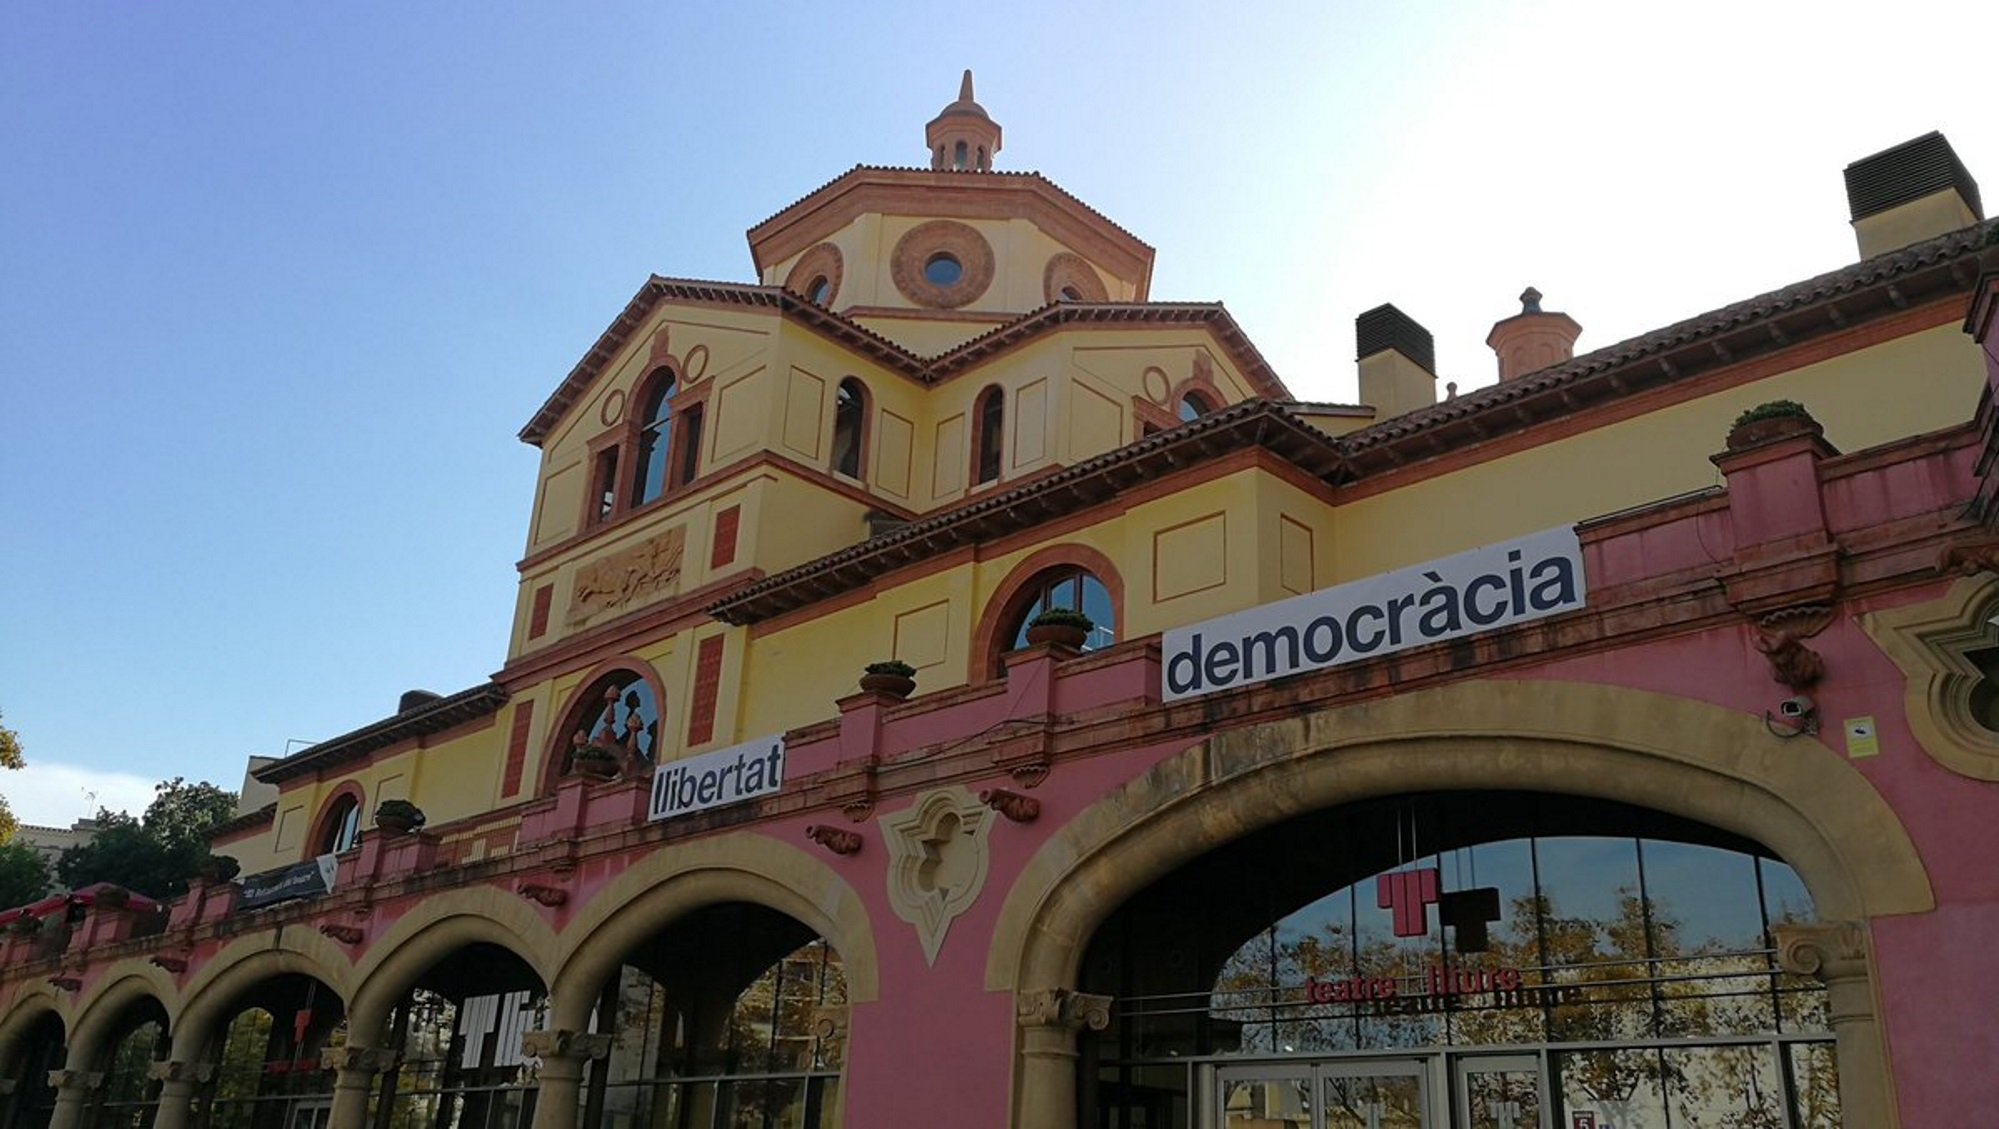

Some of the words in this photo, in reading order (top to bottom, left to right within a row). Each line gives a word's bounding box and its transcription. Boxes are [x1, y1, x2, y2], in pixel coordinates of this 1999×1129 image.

[1167, 549, 1577, 695] democràcia
[653, 744, 781, 815] llibertat
[1304, 975, 1398, 1004] teatre
[1427, 965, 1522, 997] lliure
